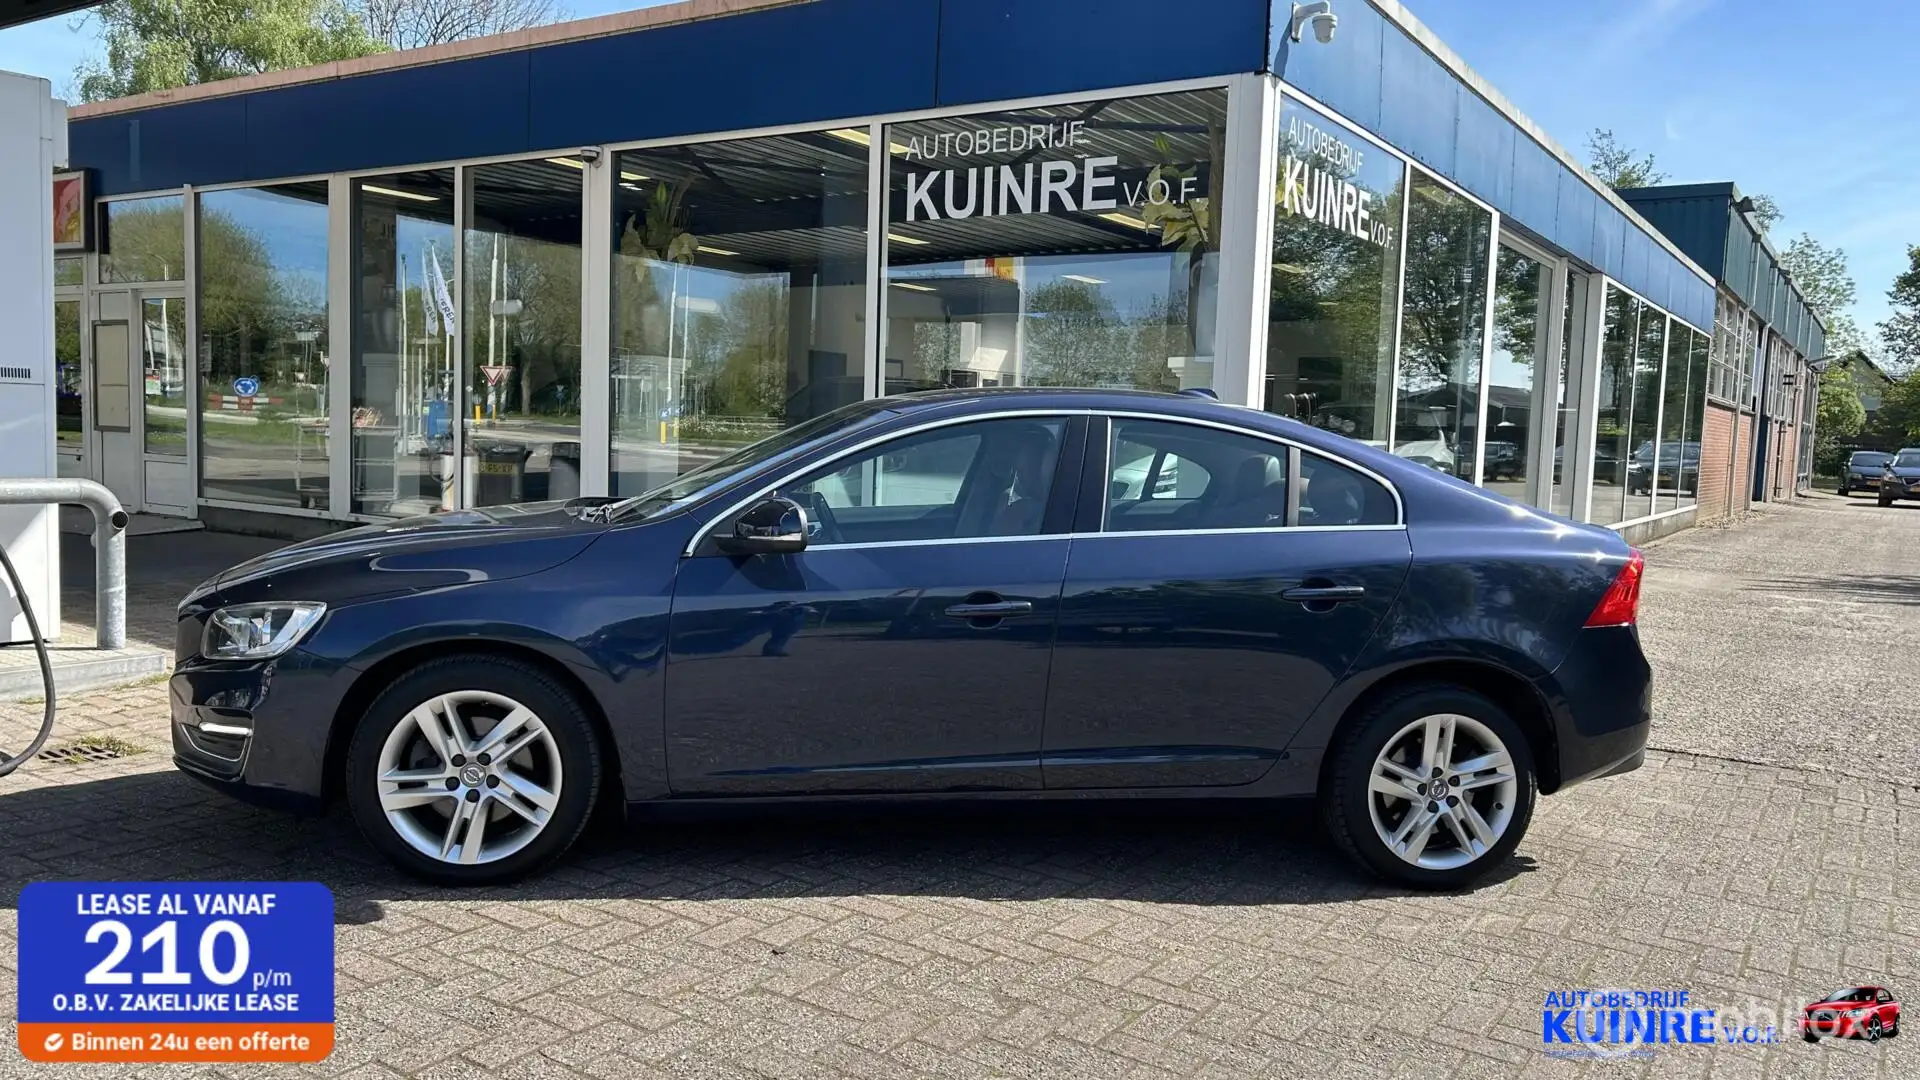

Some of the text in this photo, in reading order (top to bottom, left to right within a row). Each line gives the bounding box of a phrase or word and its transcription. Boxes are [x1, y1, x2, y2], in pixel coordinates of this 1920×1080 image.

[905, 120, 1085, 160] AUTOBEDRIJF
[1288, 116, 1363, 173] AUTOBEDRIJF
[906, 156, 1118, 222] KUINRE
[1283, 155, 1371, 241] KUINRE
